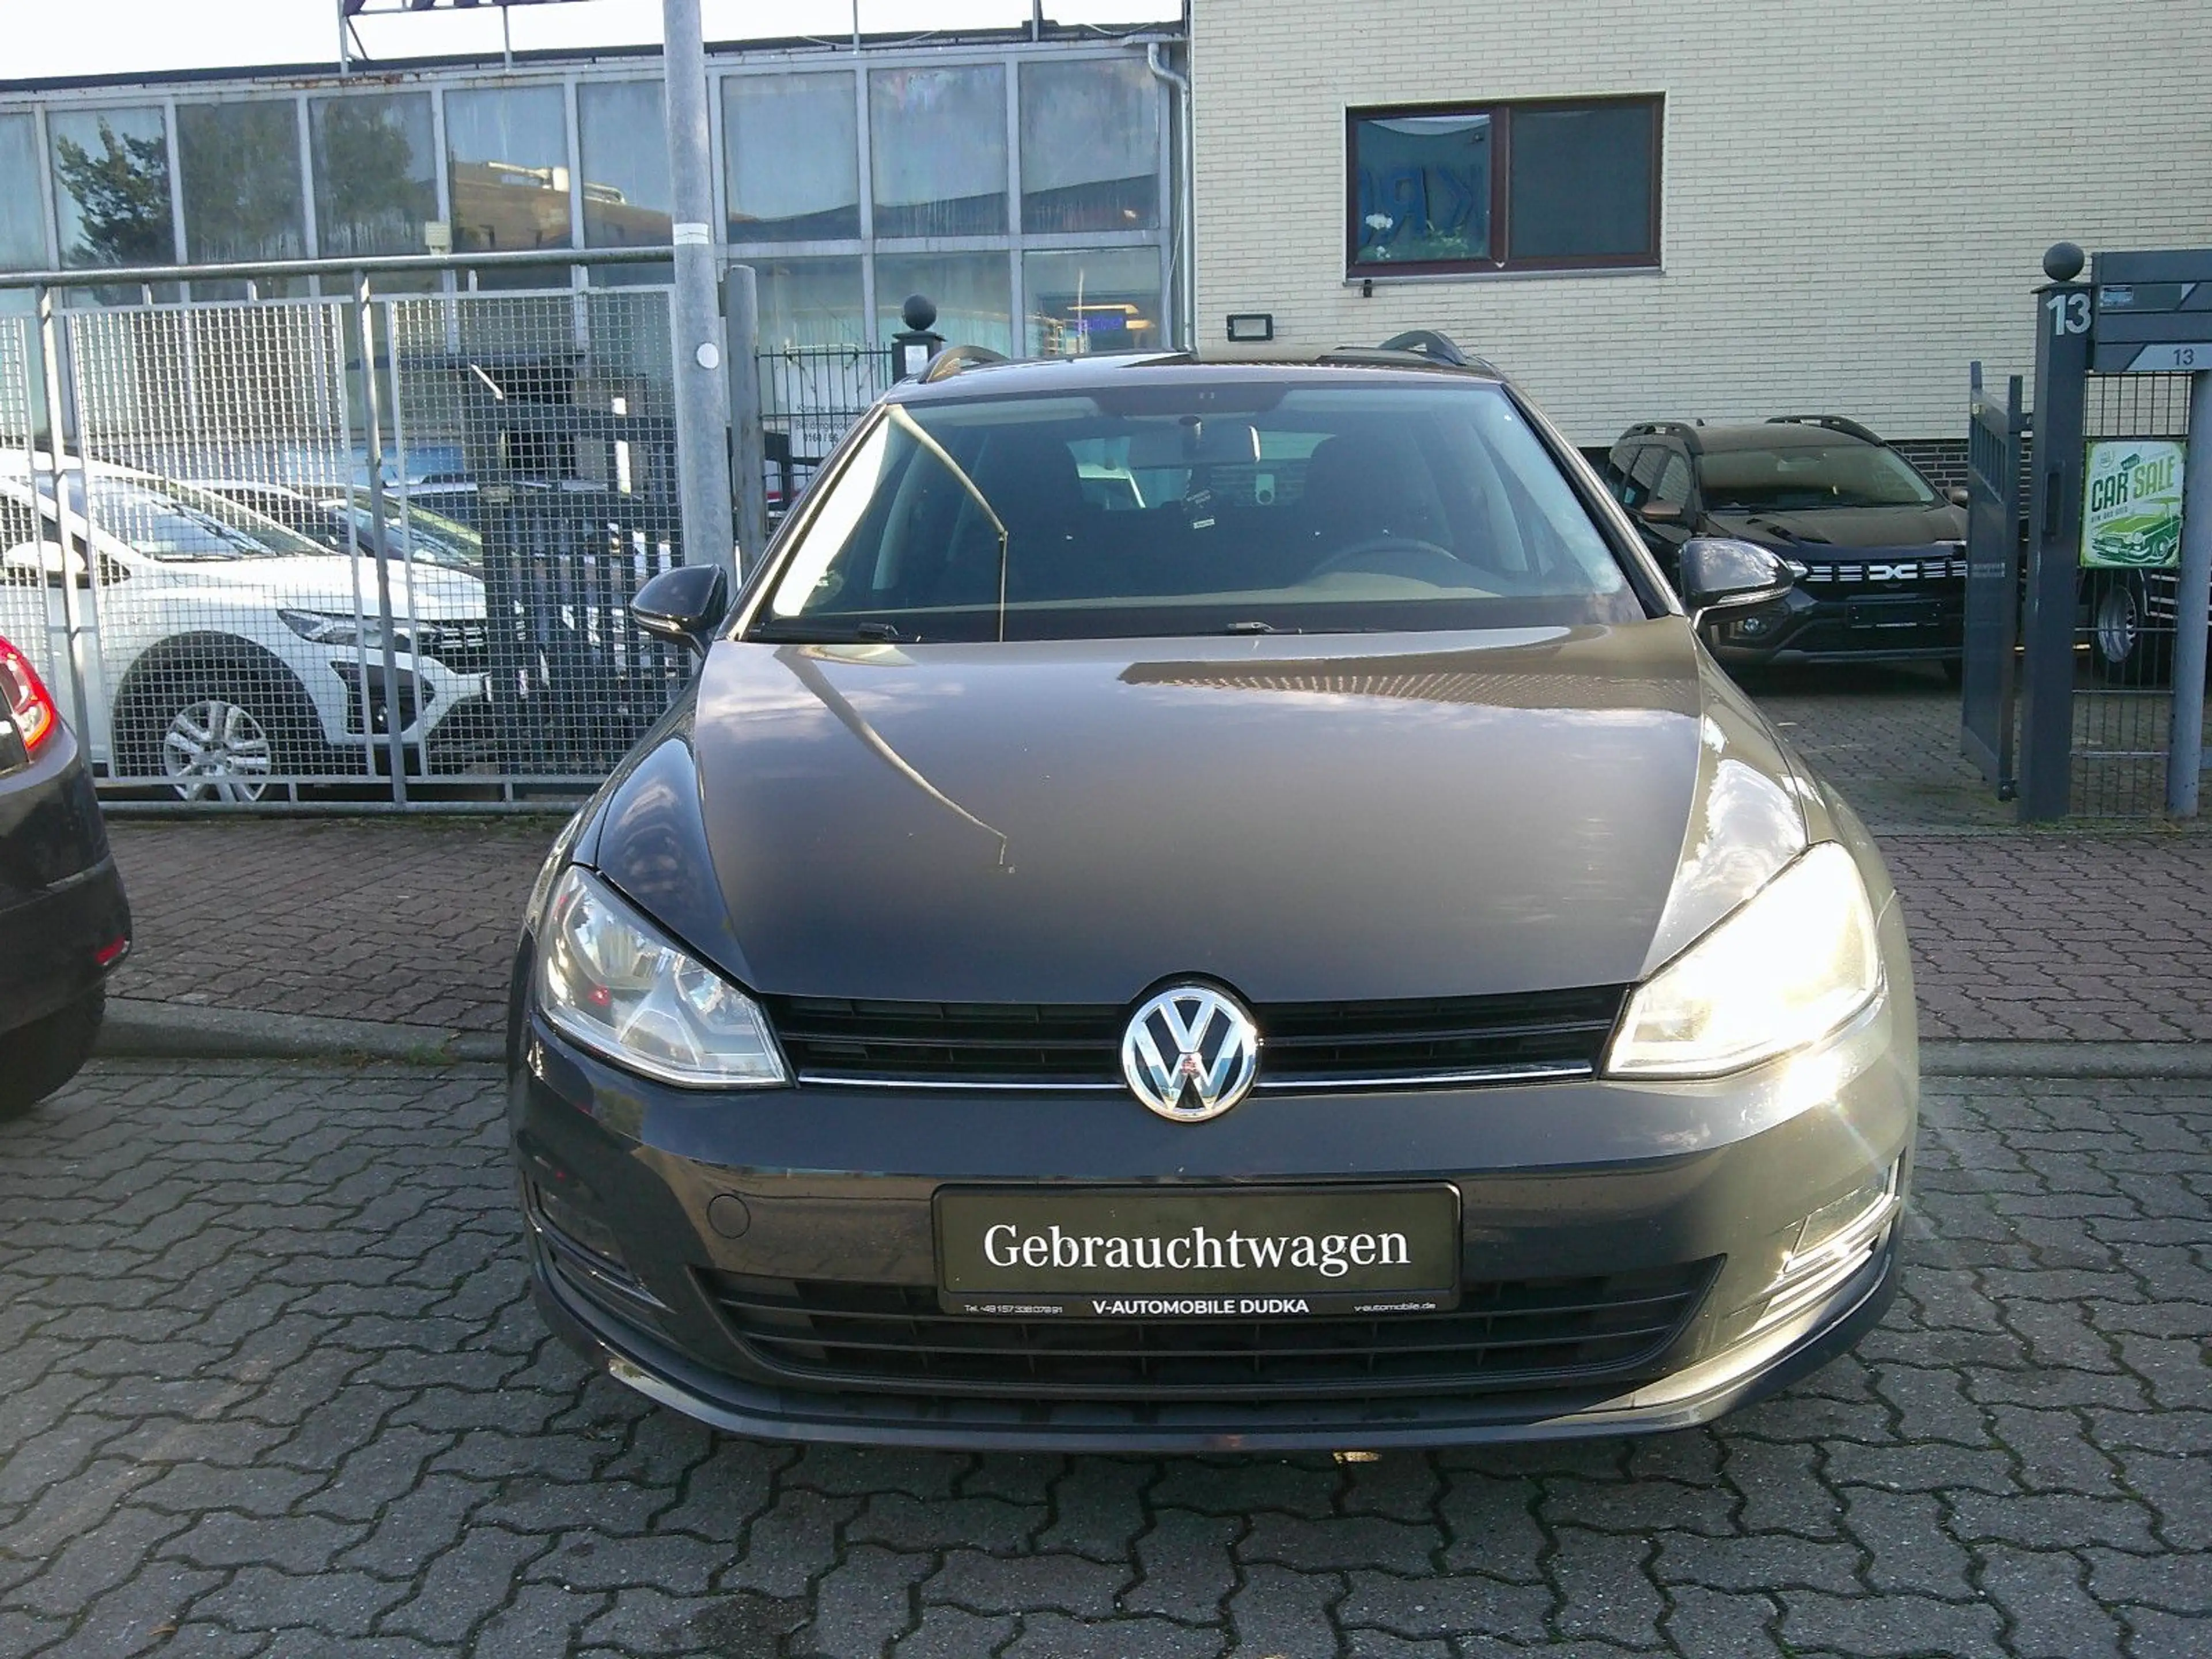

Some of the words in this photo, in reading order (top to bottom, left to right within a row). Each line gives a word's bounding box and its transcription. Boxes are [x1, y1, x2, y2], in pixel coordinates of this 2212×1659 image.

[2046, 293, 2092, 336] 13
[2173, 348, 2195, 366] 13
[2092, 472, 2129, 512] CAR
[2134, 455, 2176, 499] SALE
[983, 1224, 1412, 1278] Gebrauchtwagen
[1092, 1300, 1236, 1315] V-AUTOMOBILE
[1240, 1299, 1310, 1313] DUDKA
